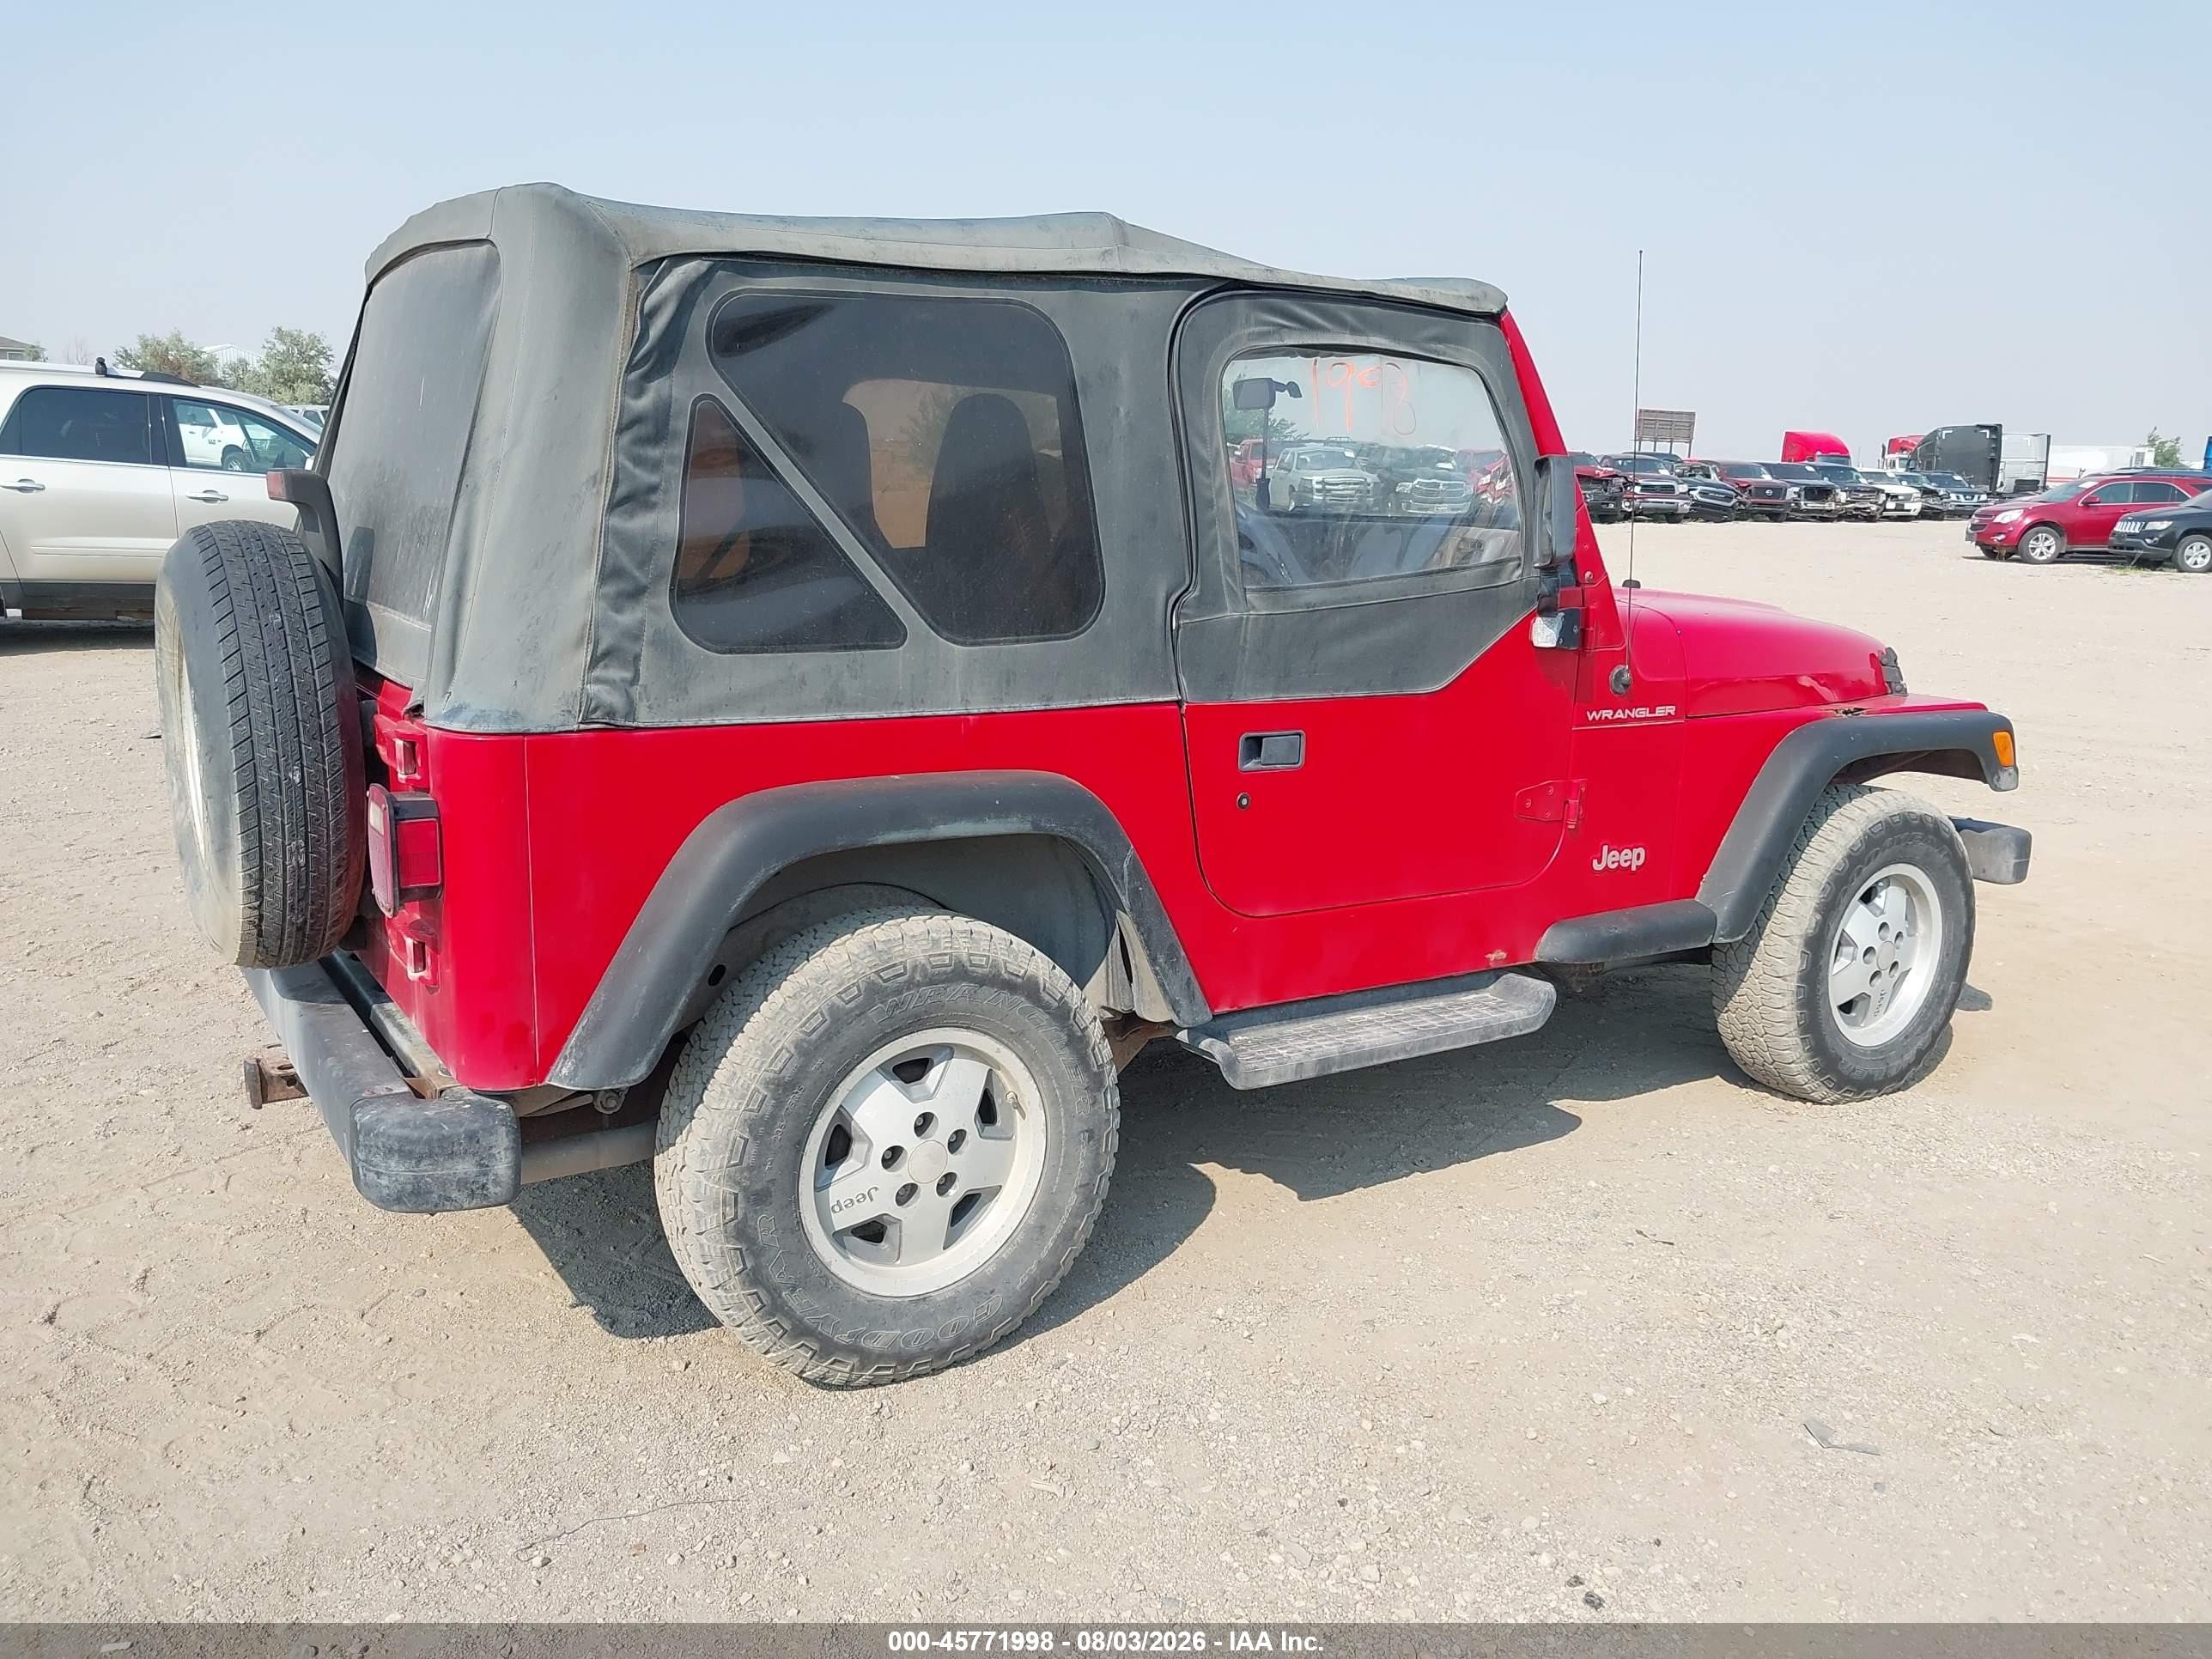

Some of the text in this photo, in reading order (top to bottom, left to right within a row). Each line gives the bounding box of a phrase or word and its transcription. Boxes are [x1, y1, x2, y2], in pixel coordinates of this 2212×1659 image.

[1587, 705, 1675, 721] WRANGLER
[1592, 844, 1646, 872] Jeep
[831, 1187, 879, 1214] Jeep
[757, 1214, 1003, 1349] GOODYEAR
